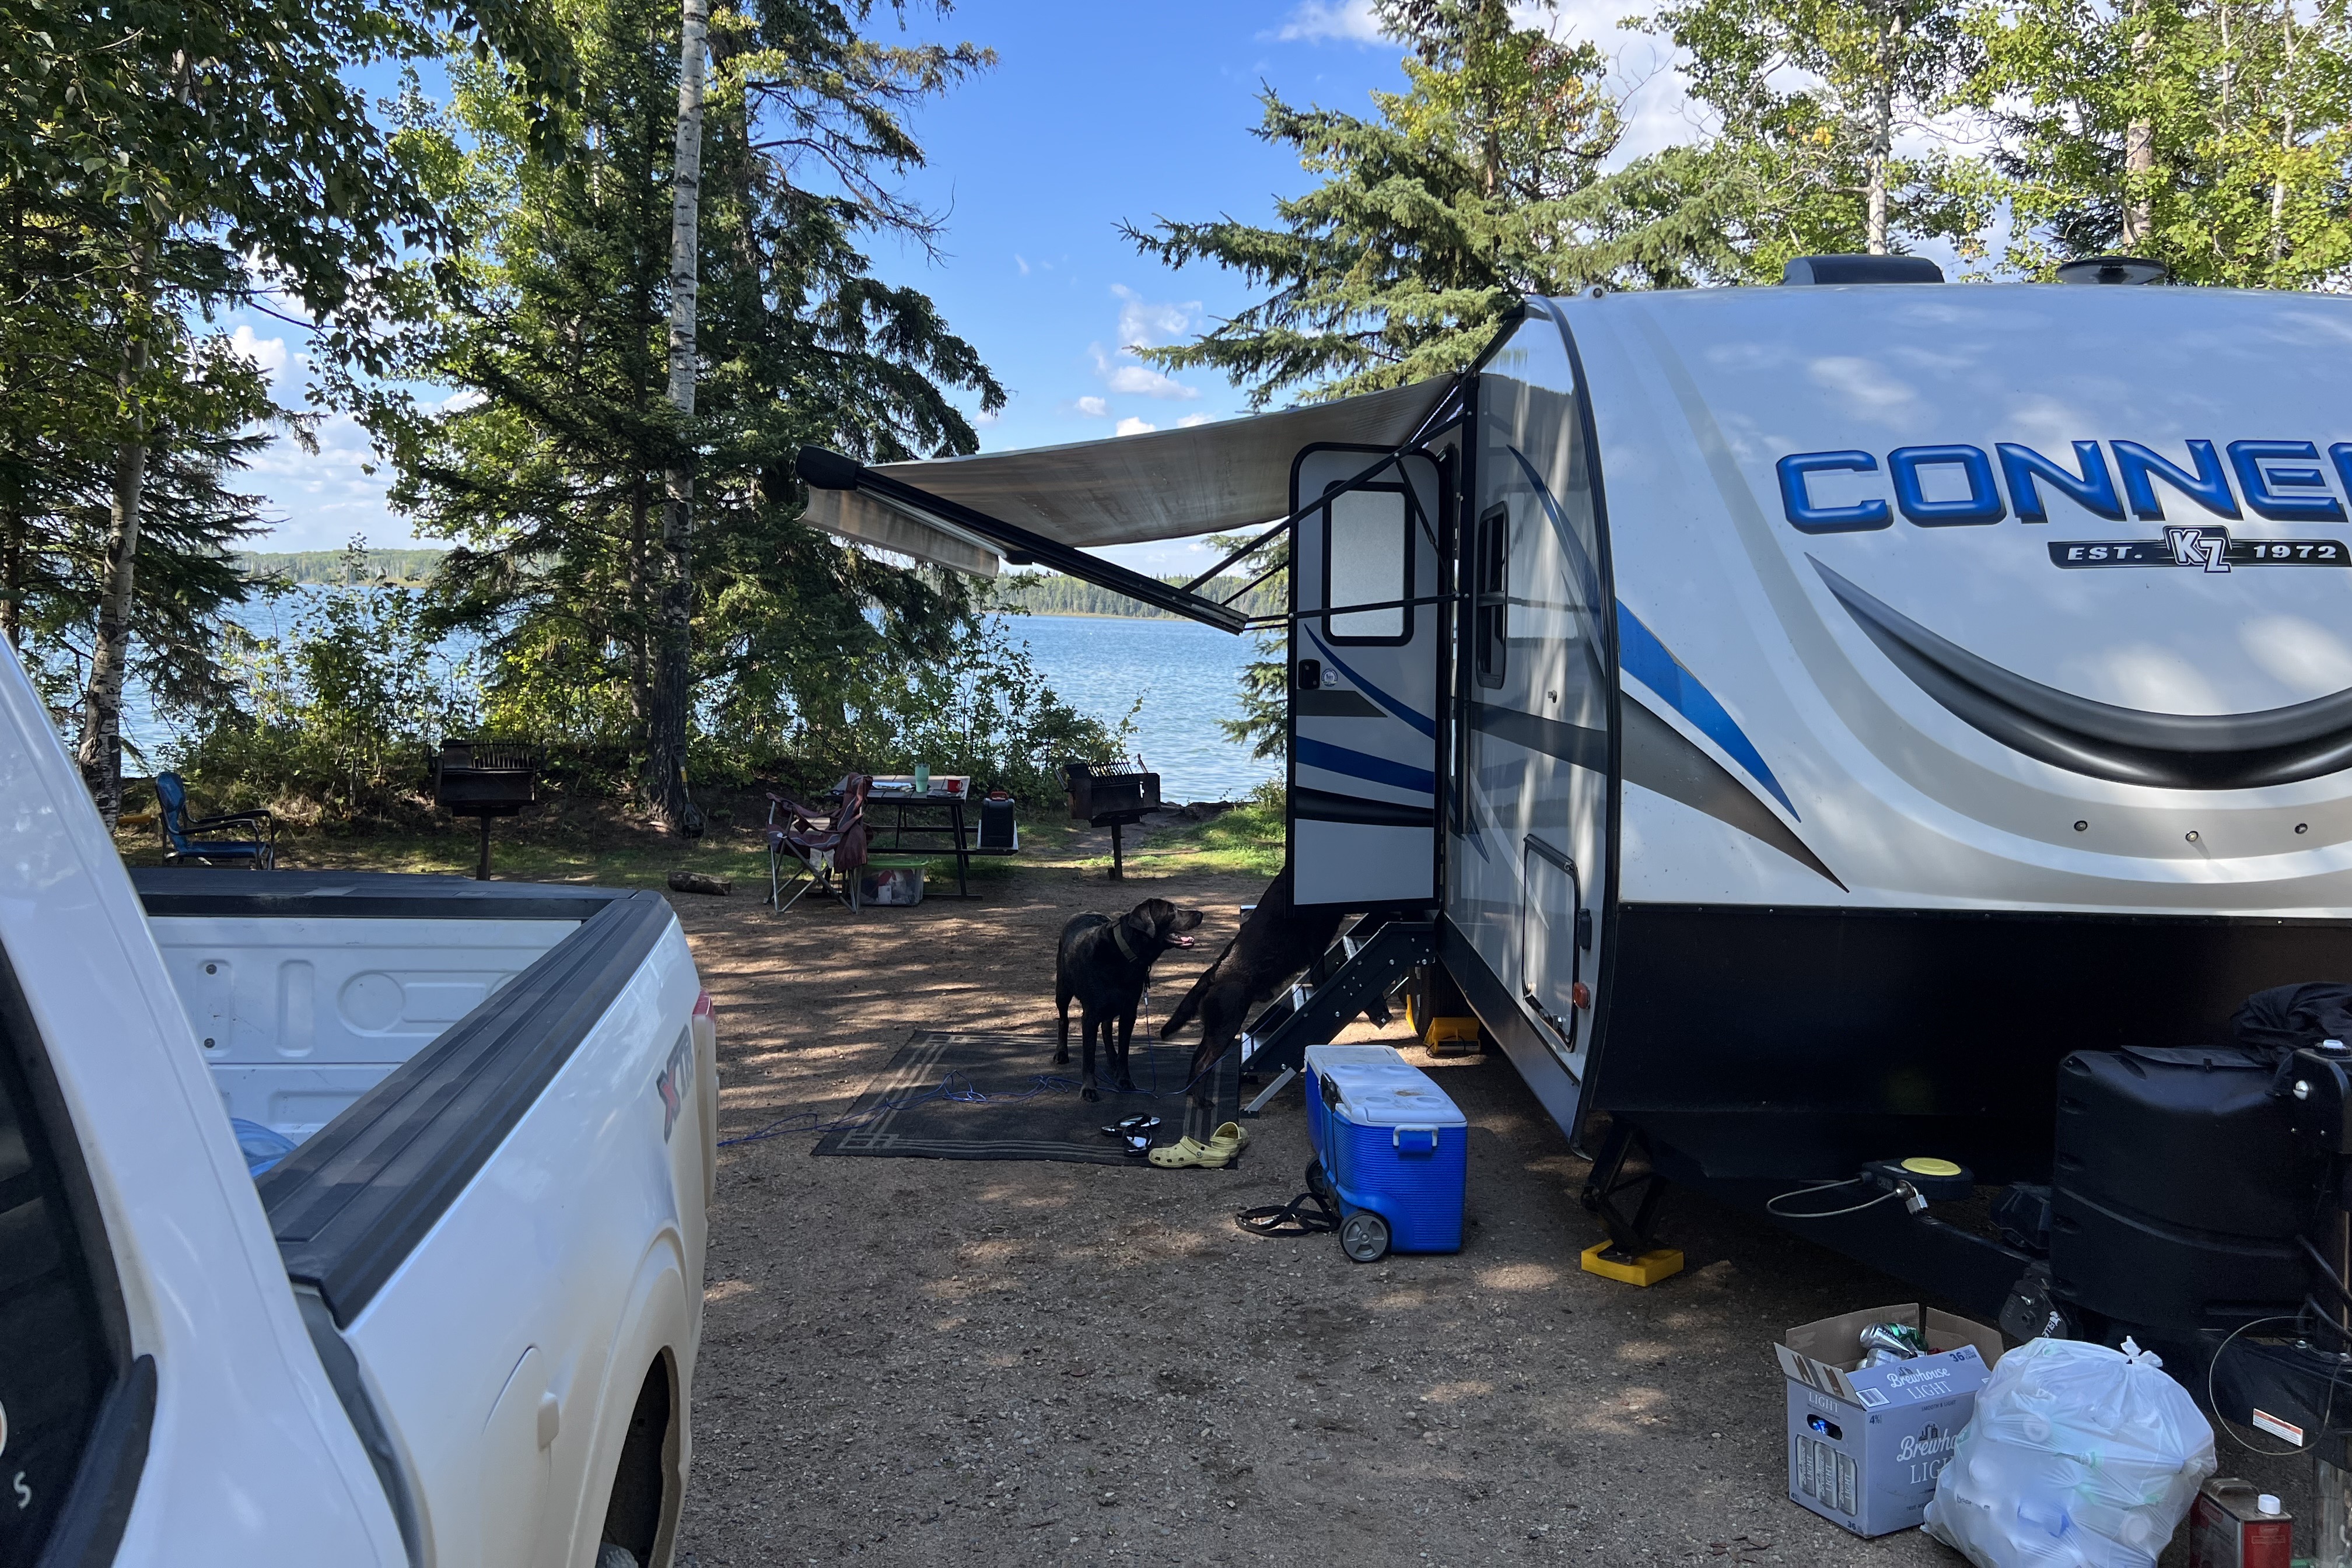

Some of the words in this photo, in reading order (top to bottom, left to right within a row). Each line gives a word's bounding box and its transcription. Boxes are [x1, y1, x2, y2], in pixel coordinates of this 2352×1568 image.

[1776, 440, 2352, 535] CONNE
[2067, 545, 2143, 561] EST.
[2169, 528, 2231, 573] KZ
[2253, 545, 2337, 559] 1972
[1949, 1352, 1965, 1362] 36
[1887, 1368, 1951, 1388] Brewhouse
[1906, 1381, 1952, 1399] LIGHT
[1809, 1391, 1840, 1412] LIGHT
[1817, 1452, 1825, 1497] Brewhouse
[1910, 1456, 1954, 1484] LIG
[1847, 1520, 1856, 1530] 36
